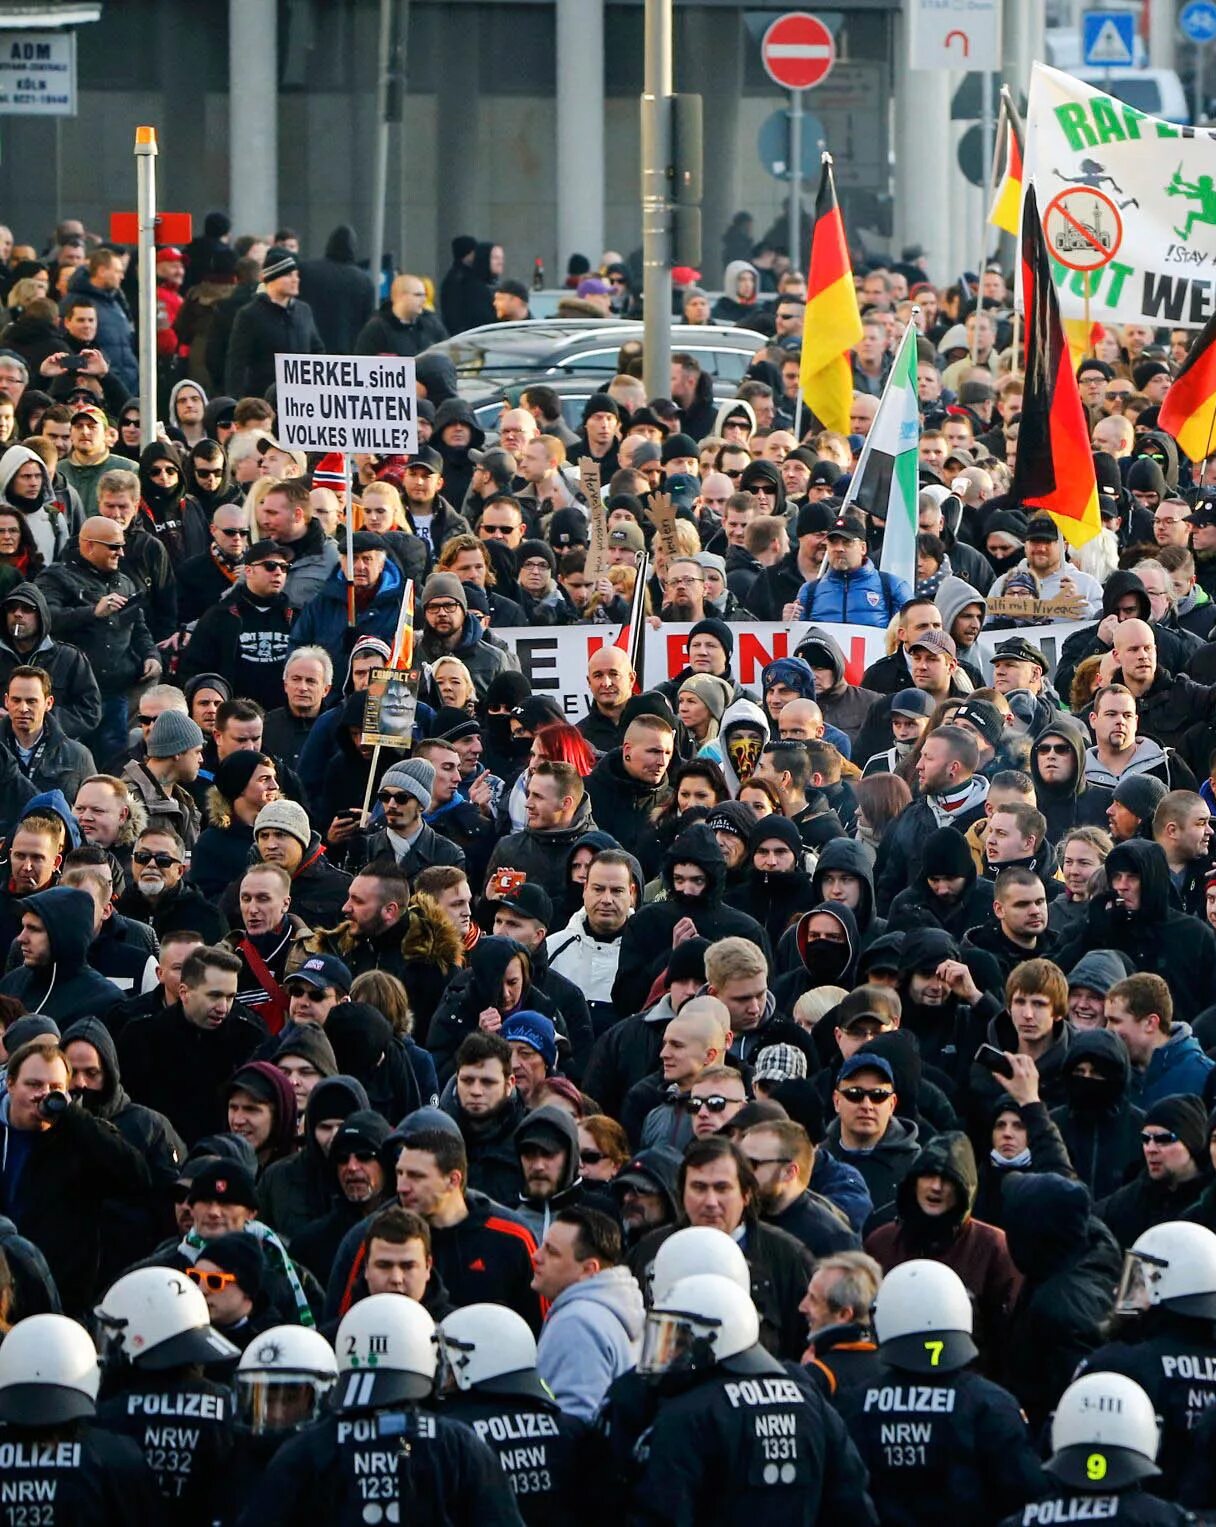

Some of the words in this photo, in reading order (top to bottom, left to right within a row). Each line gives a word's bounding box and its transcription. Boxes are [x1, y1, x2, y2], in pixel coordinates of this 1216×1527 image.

[11, 43, 51, 60] ADM
[283, 359, 365, 388] MERKEL
[368, 365, 406, 388] sind
[285, 396, 315, 418] Ihre
[319, 393, 411, 421] UNTATEN
[285, 424, 347, 447] VOLKES
[351, 428, 410, 449] WILLE?
[371, 670, 409, 682] COMPACT
[168, 1279, 187, 1296] 2
[924, 1340, 944, 1366] 7
[724, 1378, 805, 1409] POLIZEI
[863, 1386, 957, 1413] POLIZEI
[127, 1392, 225, 1422] POLIZEI
[472, 1413, 560, 1444] POLIZEI
[755, 1413, 797, 1438] NRW
[881, 1423, 933, 1445] NRW
[144, 1426, 201, 1451] NRW
[762, 1437, 797, 1460] 1331
[0, 1442, 82, 1468] OLIZEI
[500, 1445, 546, 1472] NRW
[884, 1444, 927, 1466] 1331
[1086, 1453, 1107, 1480] 9
[2, 1479, 57, 1503] NRW
[357, 1477, 400, 1500] 123
[510, 1469, 552, 1494] 1333
[6, 1504, 55, 1527] 1232
[1022, 1496, 1119, 1527] POLIZEI
